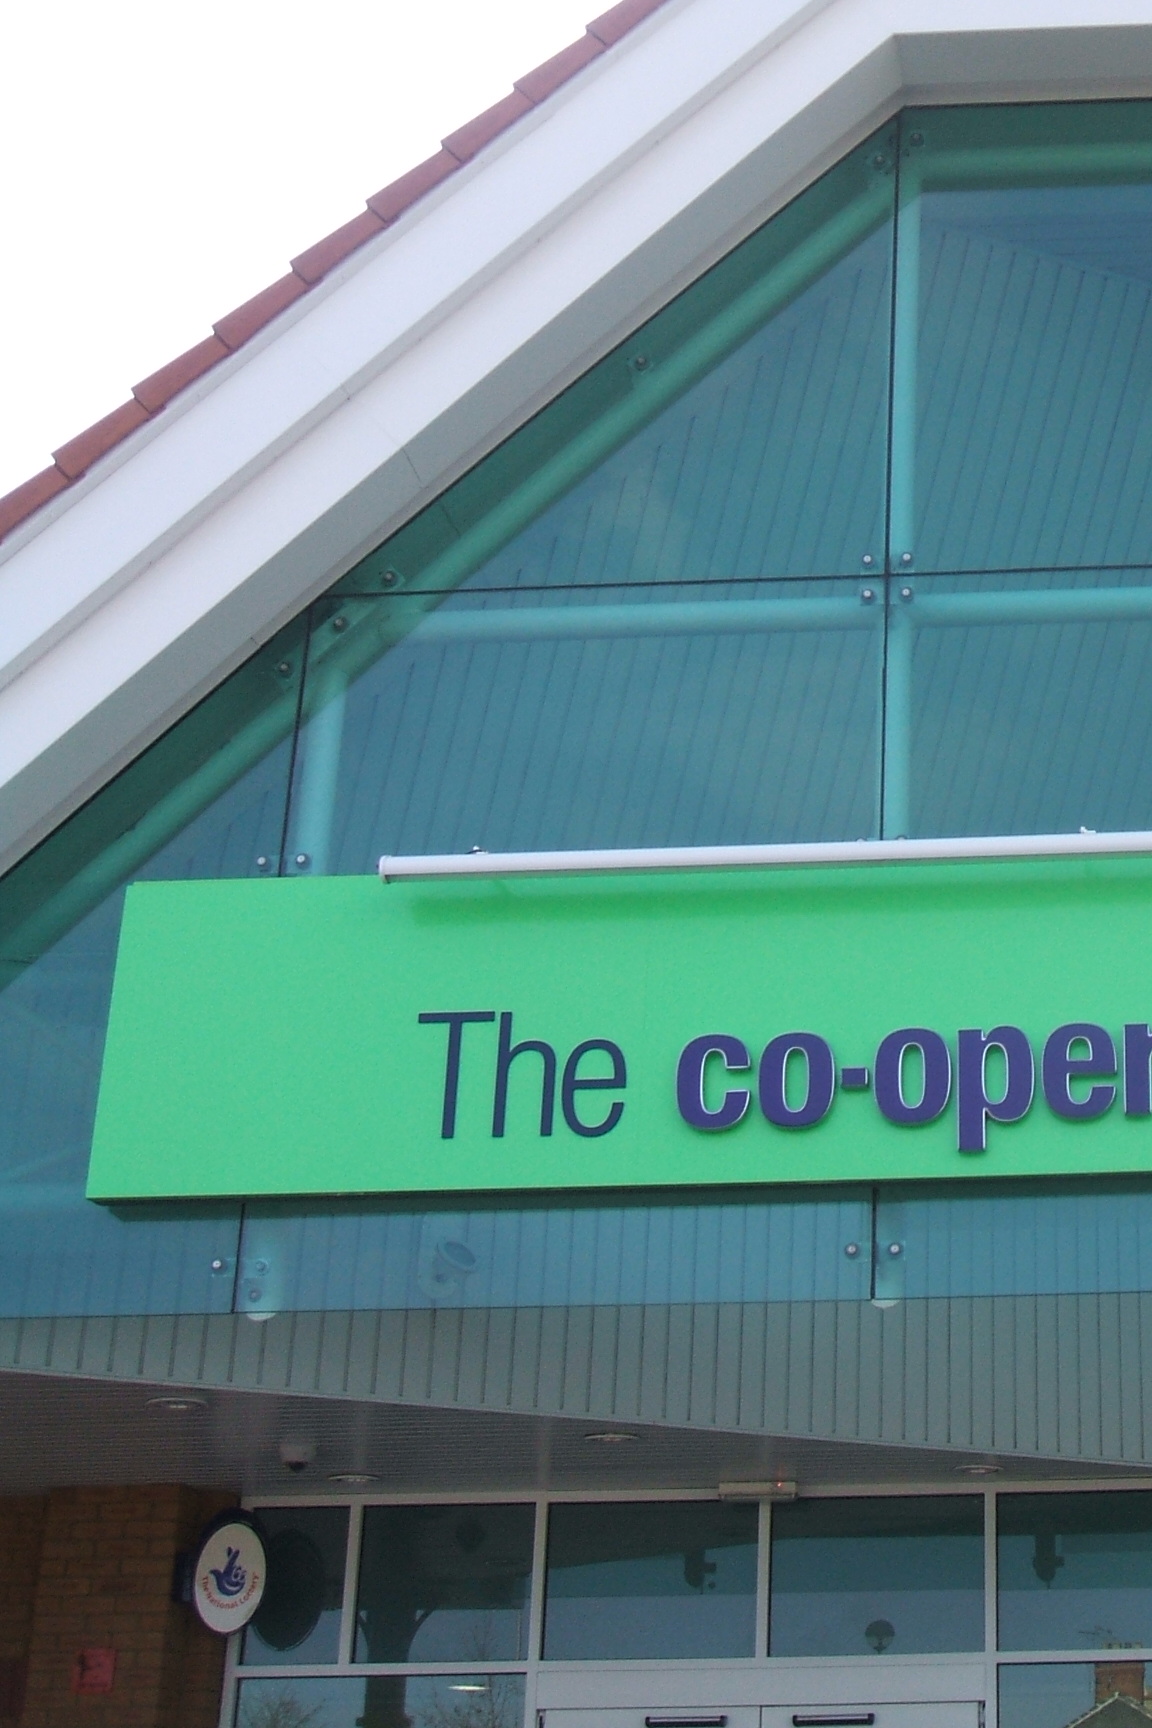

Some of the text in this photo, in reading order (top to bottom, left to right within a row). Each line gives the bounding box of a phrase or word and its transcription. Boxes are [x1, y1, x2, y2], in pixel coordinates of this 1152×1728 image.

[417, 1010, 627, 1139] The
[206, 1591, 239, 1609] National
[240, 1571, 259, 1604] Lottery
